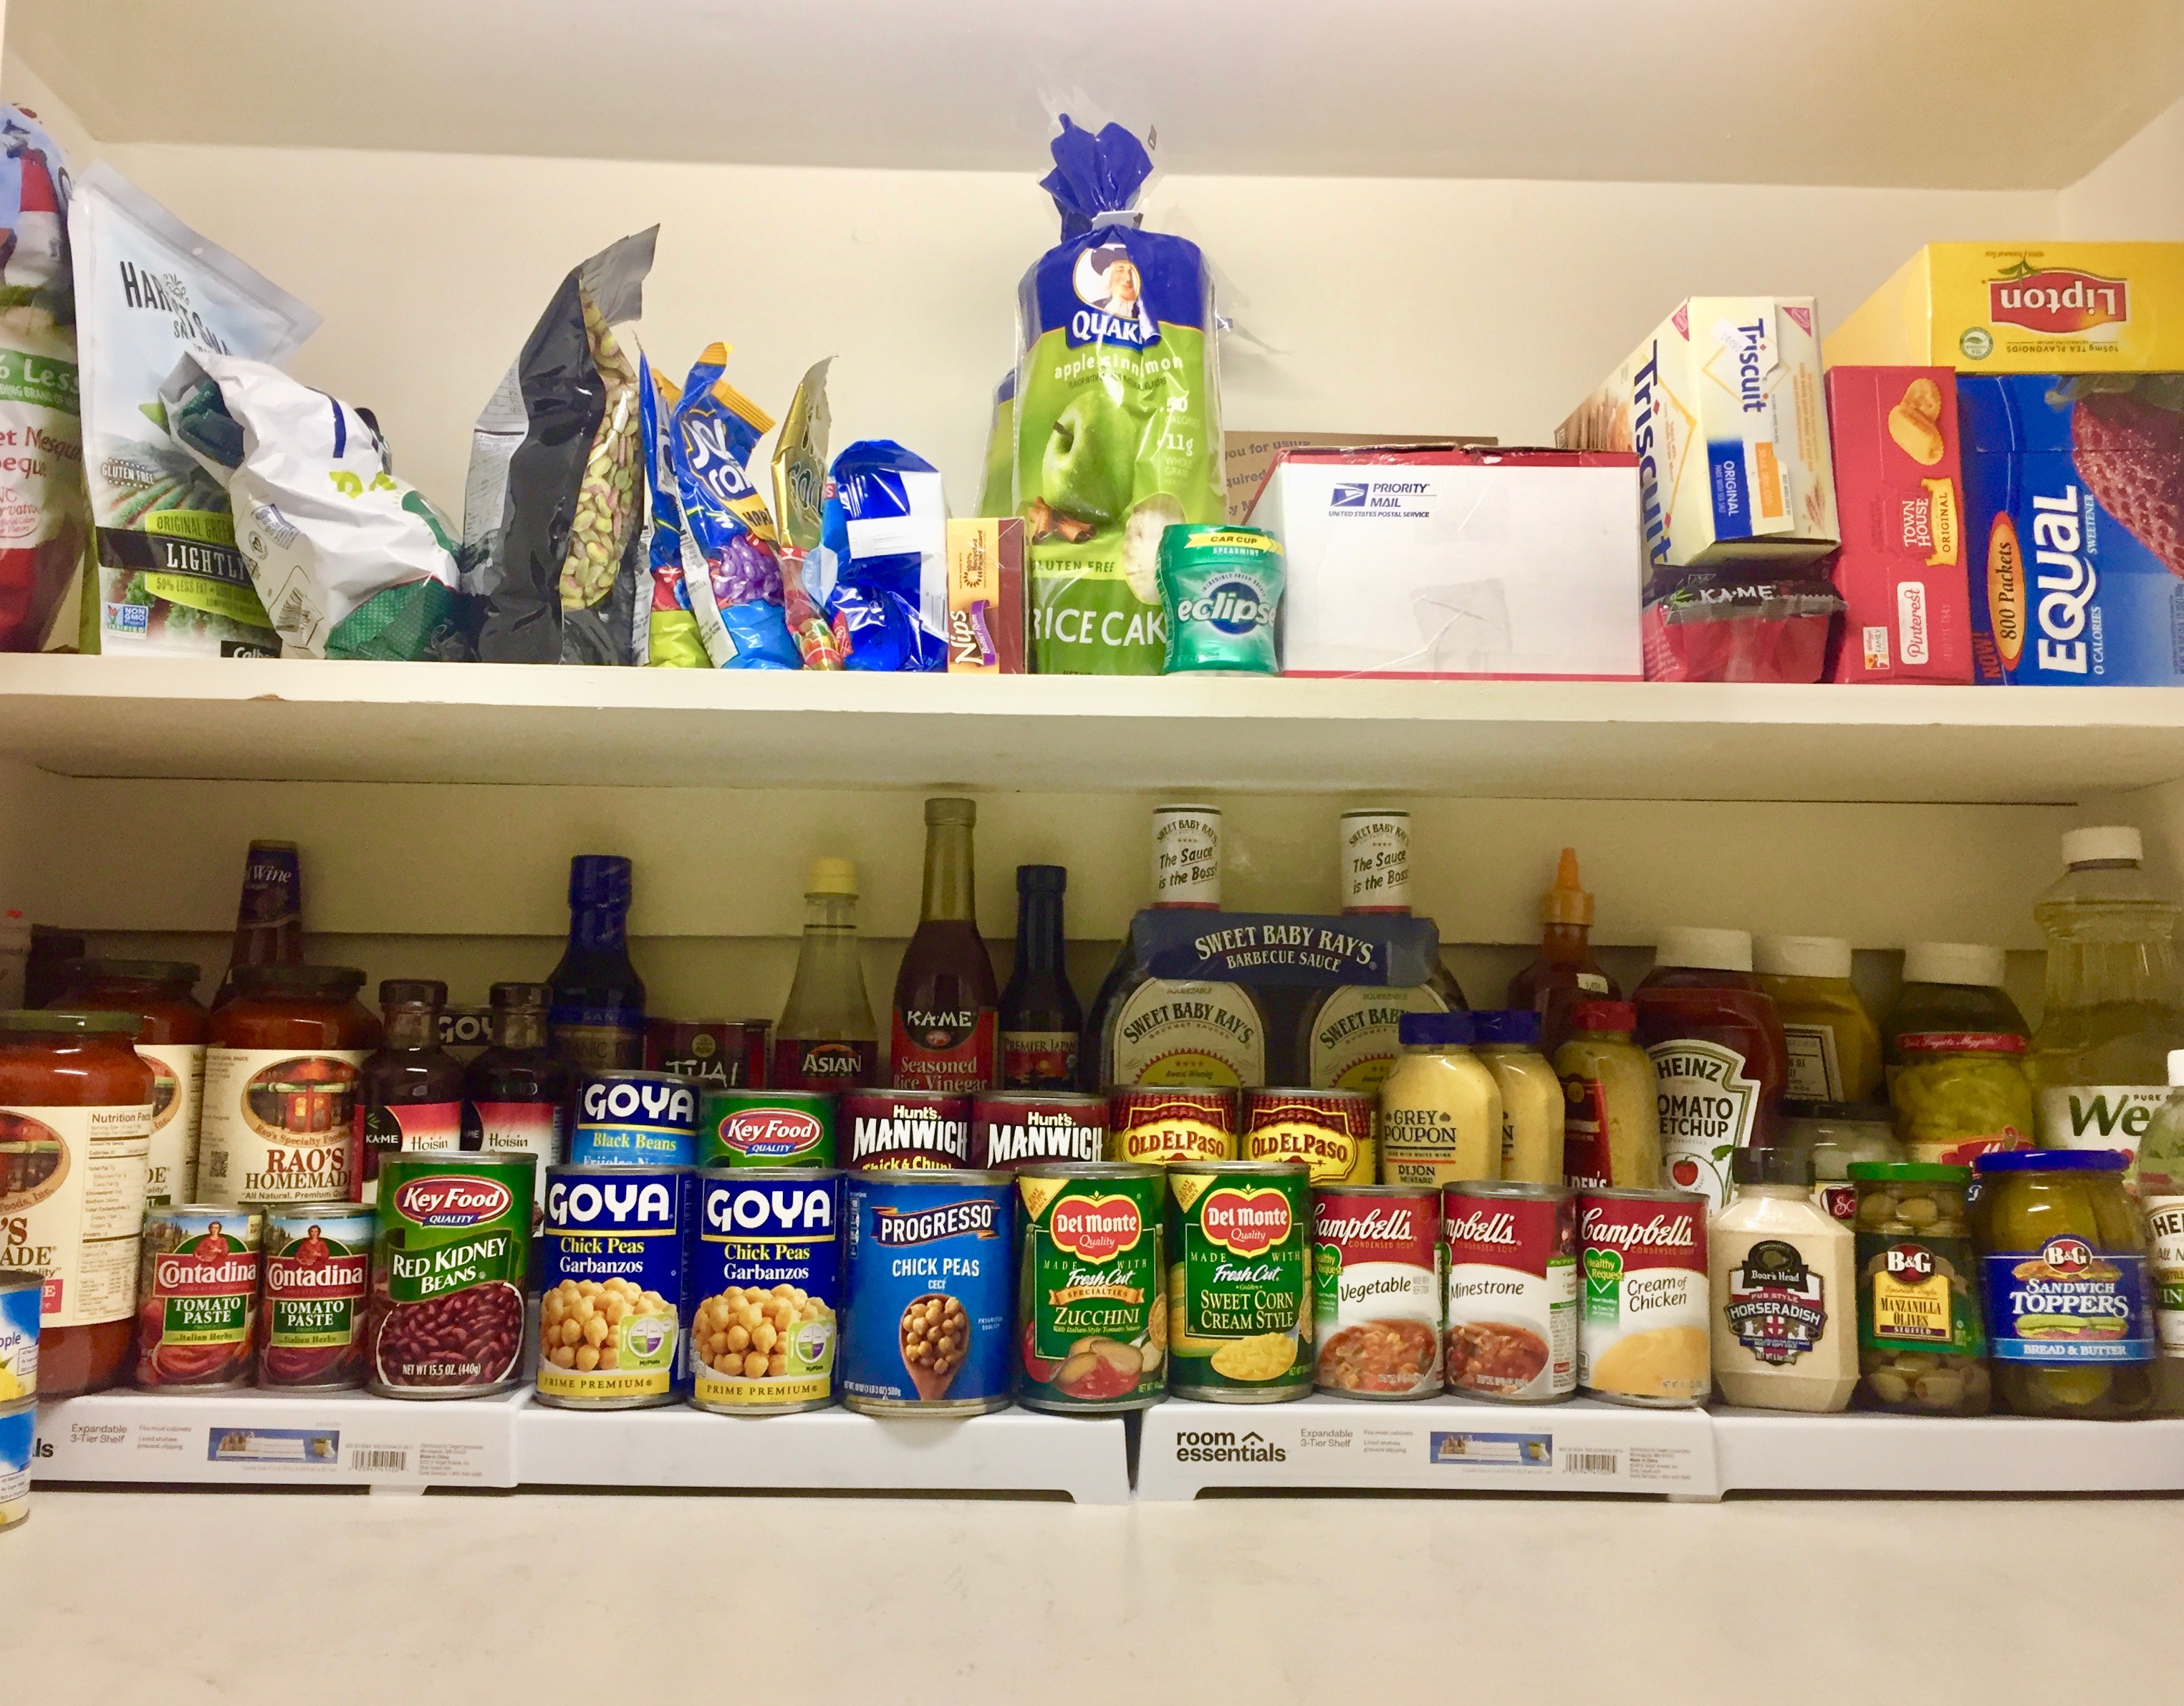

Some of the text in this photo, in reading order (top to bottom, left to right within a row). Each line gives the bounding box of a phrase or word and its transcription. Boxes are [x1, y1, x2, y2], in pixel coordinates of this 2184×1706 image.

[2000, 281, 2116, 316] Lipton
[1737, 318, 1767, 413] Triscuit
[1167, 434, 1193, 456] 11g
[1633, 339, 1672, 564] Triscuit
[102, 464, 155, 484] GLUTEN FREE
[1372, 483, 1428, 493] PRIORITY
[1723, 461, 1739, 517] ORIGINAL
[1370, 498, 1401, 508] MAIL
[1902, 501, 1917, 547] TOWN
[1917, 498, 1931, 547] HOUSE
[1939, 493, 1951, 553] ORIGINAL
[2084, 494, 2097, 555] SWEETENER
[1213, 547, 1259, 556] SPEARMINT
[157, 577, 206, 594] 50% LESS FAT
[1995, 542, 2017, 640] 800 Packets
[1178, 592, 1276, 629] eclipse
[1904, 588, 1925, 657] Pinterest
[951, 610, 984, 665] Nips
[1160, 846, 1213, 869] The Sauce
[1354, 849, 1406, 873] The Sauce
[252, 864, 292, 884] Wine
[1194, 925, 1374, 964] SWEET BABY RAY'S
[1226, 950, 1342, 973] BARBECUE SAUCE
[1124, 1003, 1254, 1044] SWEET BABY RAY'S
[802, 1054, 862, 1073] ASIAN
[901, 1056, 978, 1074] Seasoned
[1658, 1059, 1722, 1082] HEINZ
[894, 1074, 987, 1092] Rice Vinegar
[584, 1083, 695, 1123] GOYA
[1395, 1110, 1438, 1125] GREY
[727, 1119, 813, 1139] Key Food
[1384, 1125, 1456, 1143] POUPON
[411, 1136, 448, 1150] Hoisin
[489, 1133, 528, 1147] Hoisin
[593, 1132, 677, 1152] Black Beans
[752, 1144, 792, 1153] QUALITY
[852, 1117, 968, 1162] MANWICH
[987, 1124, 1103, 1170] MANWICH
[1128, 1134, 1160, 1155] OLD
[1162, 1131, 1184, 1150] EL
[266, 1147, 345, 1173] RAO'S
[1398, 1165, 1435, 1175] DIJON
[403, 1186, 500, 1213] Key Food
[549, 1183, 670, 1226] GOYA
[428, 1214, 474, 1224] QUALITY
[706, 1189, 832, 1233] GOYA
[1208, 1207, 1287, 1226] Del Monte
[881, 1205, 992, 1243] PROGRESSO
[1057, 1214, 1137, 1233] Del Monte
[1582, 1207, 1694, 1251] Campbell's
[1079, 1234, 1115, 1248] Quality
[1231, 1228, 1266, 1242] Quality
[560, 1237, 645, 1254] Chick Peas
[723, 1243, 810, 1260] Chick Peas
[393, 1235, 507, 1278] RED KIDNEY
[559, 1256, 643, 1273] Garbanzos
[1044, 1259, 1147, 1270] MADE WITH
[1190, 1250, 1302, 1263] MADE WITH
[1587, 1257, 1615, 1272] Healthy
[1887, 1250, 1932, 1273] B&G
[2047, 1247, 2088, 1266] B&G
[158, 1261, 257, 1288] Contadina
[268, 1263, 363, 1291] Contadina
[723, 1262, 809, 1280] Garbanzos
[892, 1258, 980, 1278] CHICK PEAS
[1213, 1263, 1280, 1283] Fresh Cut
[1592, 1268, 1623, 1281] Request
[1751, 1270, 1799, 1282] Boar's Head
[420, 1265, 476, 1295] BEANS
[1067, 1268, 1137, 1288] Fresh Cut
[1627, 1276, 1688, 1296] Cream of
[2026, 1278, 2115, 1294] SANDWICH
[1067, 1288, 1128, 1298] SPECIALTIES
[1340, 1276, 1411, 1303] Vegetable
[1450, 1282, 1524, 1301] Minestrone
[1771, 1293, 1799, 1303] STYLE
[174, 1297, 241, 1312] TOMATO
[279, 1300, 345, 1314] TOMATO
[1201, 1291, 1294, 1311] SWEET CORN
[1630, 1292, 1687, 1312] Chicken
[1881, 1298, 1942, 1315] MANZANILLA
[2010, 1293, 2129, 1319] TOPPERS
[183, 1311, 231, 1324] PASTE
[287, 1314, 334, 1327] PASTE
[1054, 1307, 1140, 1325] ZUCCHINI
[1201, 1310, 1294, 1330] CREAM STYLE
[1731, 1303, 1821, 1325] HORSERADISH
[1894, 1313, 1928, 1326] OLIVES
[2024, 1344, 2127, 1356] BREAD & BUTTER
[403, 1362, 481, 1377] NET WT 15.5 OZ. (440g)
[544, 1378, 645, 1389] PRIME PREMIUM
[706, 1384, 810, 1396] PRIME PREMIUM
[72, 1424, 127, 1433] Expandable
[1301, 1429, 1353, 1439] Expandable
[100, 1435, 125, 1443] Shelf
[1176, 1432, 1235, 1447] room
[1328, 1439, 1351, 1447] Shelf
[1176, 1445, 1286, 1462] essentials
